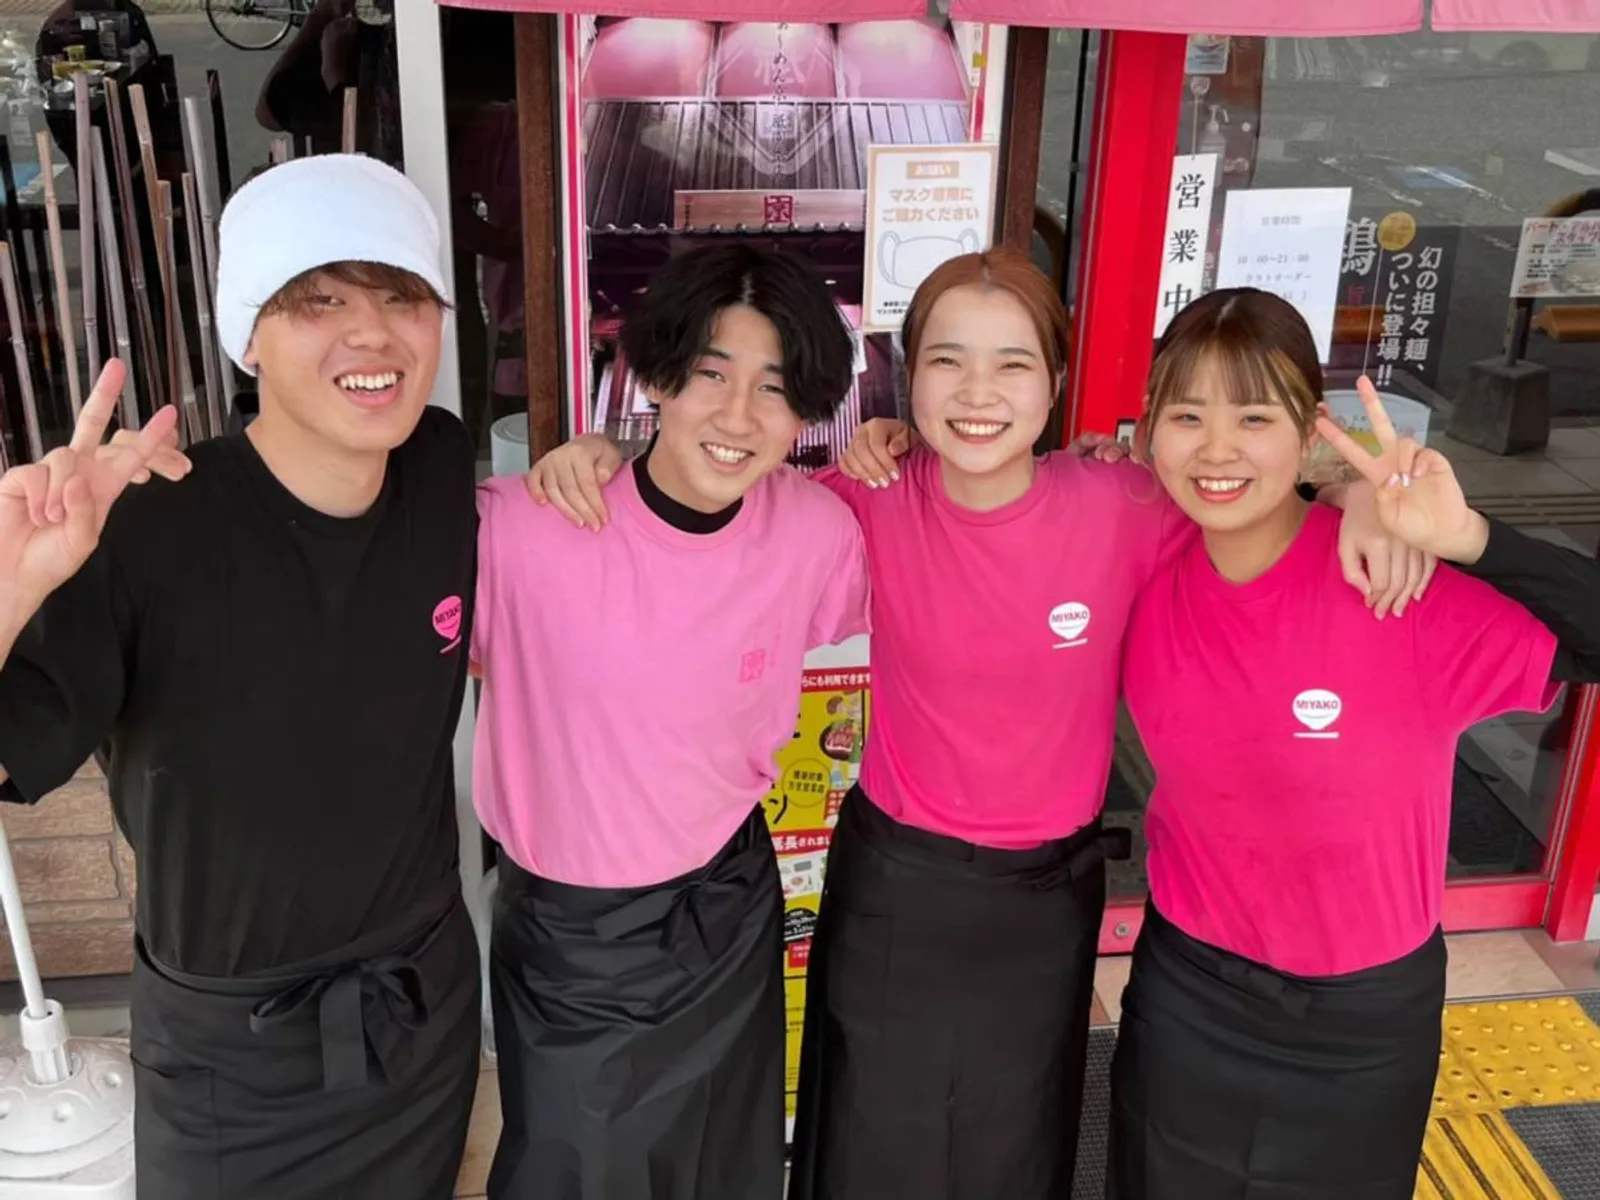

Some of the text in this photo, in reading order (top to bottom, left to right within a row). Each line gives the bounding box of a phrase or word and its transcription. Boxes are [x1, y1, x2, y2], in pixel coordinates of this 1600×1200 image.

[1164, 173, 1206, 316] 営業中
[1052, 610, 1088, 622] MIYAKO
[1296, 699, 1339, 710] MIYAKO
